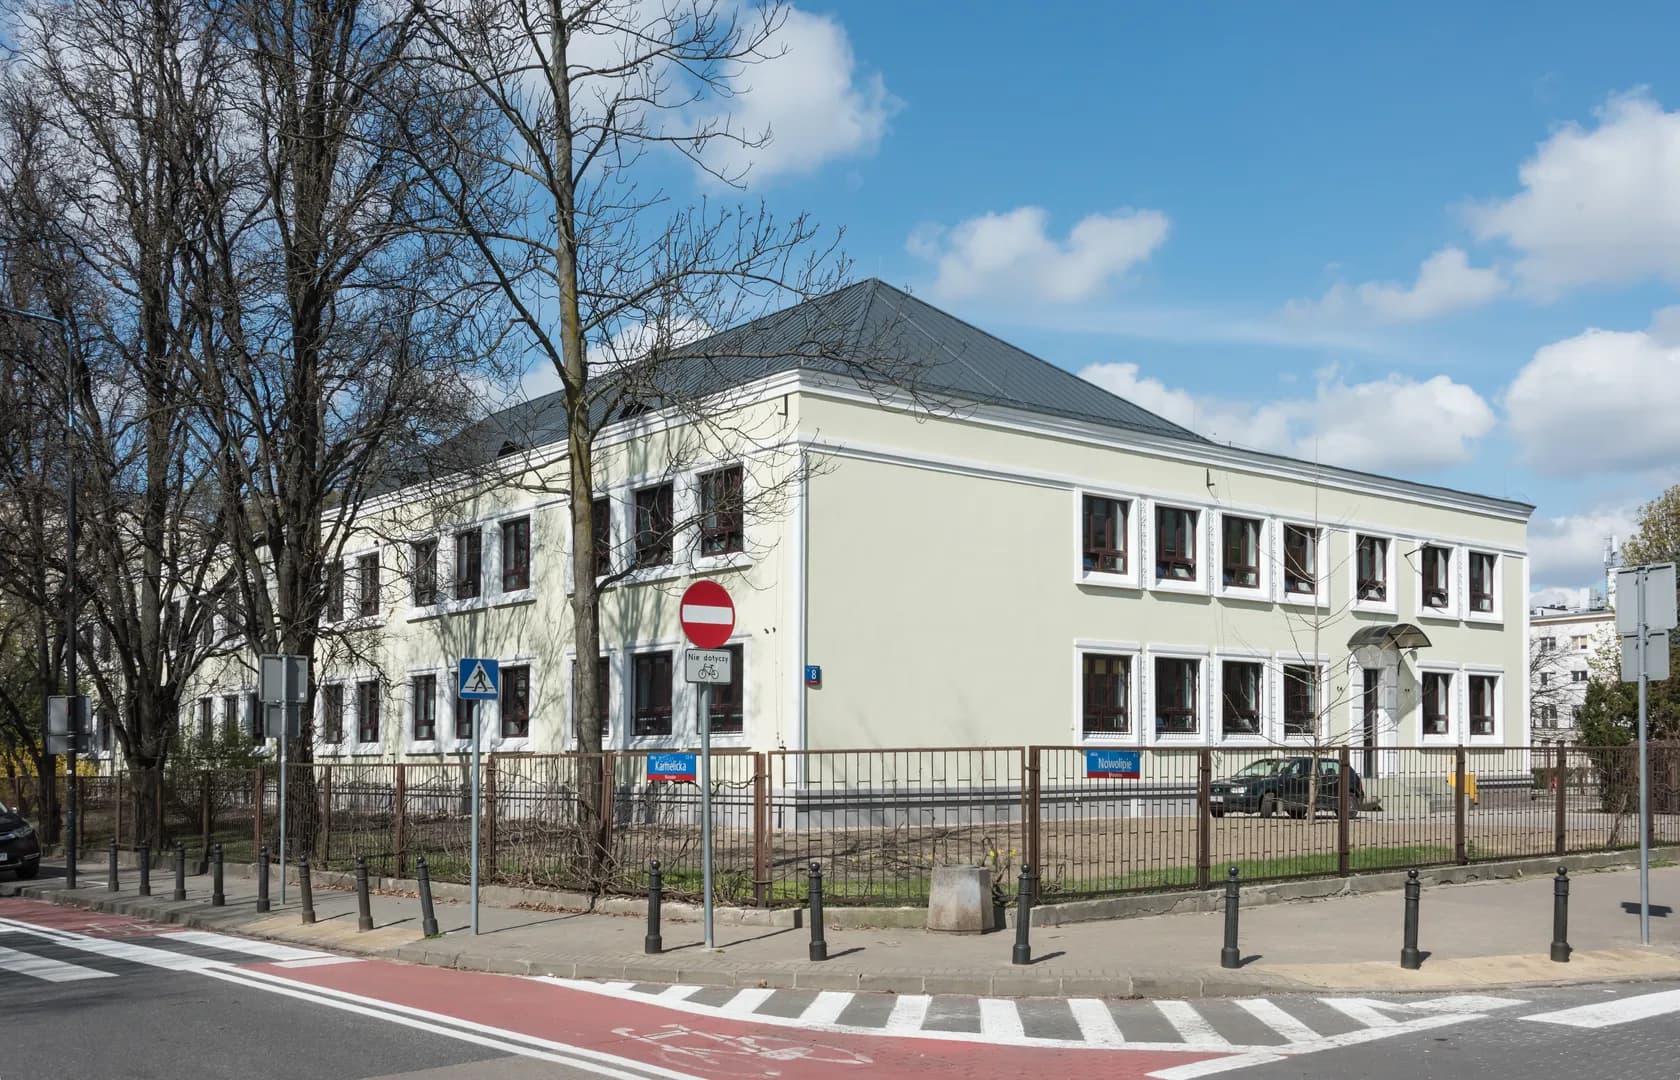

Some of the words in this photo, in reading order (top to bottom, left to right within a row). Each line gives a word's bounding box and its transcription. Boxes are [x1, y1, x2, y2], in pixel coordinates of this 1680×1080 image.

[688, 653, 700, 661] Nie
[703, 653, 729, 664] dotyczy
[811, 669, 817, 680] 8
[655, 759, 687, 772] Karmelicka
[1098, 757, 1132, 771] Nowolipie
